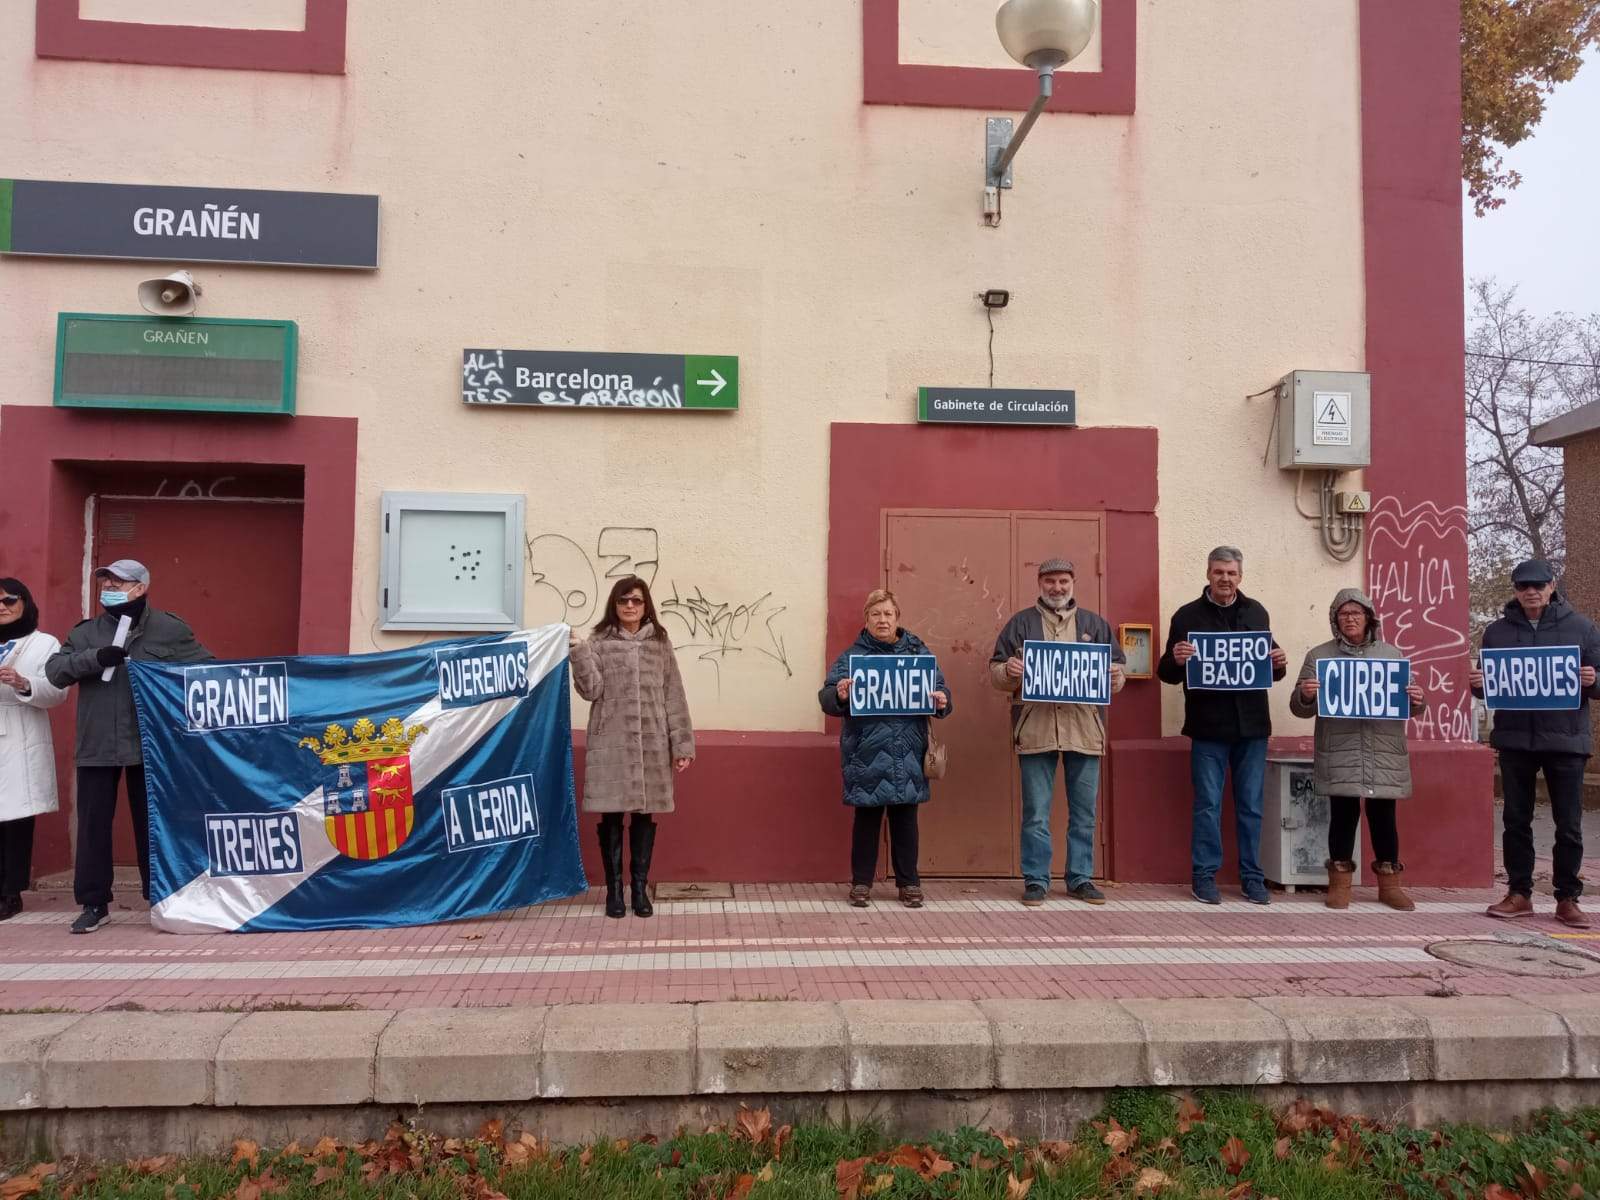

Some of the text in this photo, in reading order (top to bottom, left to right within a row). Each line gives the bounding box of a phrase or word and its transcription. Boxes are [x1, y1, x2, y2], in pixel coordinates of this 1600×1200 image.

[133, 203, 260, 240] GRAÑÉN
[143, 328, 209, 346] GRAÑEN
[516, 367, 633, 391] Barcelona
[934, 399, 1069, 413] Gabinete de Circulación
[1188, 636, 1269, 662] ALBERO
[439, 652, 527, 701] QUEREMOS
[852, 658, 935, 710] GRAÑÉN
[1024, 648, 1108, 700] SANGARREN
[1202, 661, 1256, 686] BAJO
[1325, 661, 1400, 717] CURBE
[1428, 665, 1454, 693] DE
[1484, 654, 1579, 698] BARBUES
[187, 667, 286, 729] GRAÑÉN
[448, 791, 535, 846] A LERIDA
[210, 815, 298, 873] TRENES
